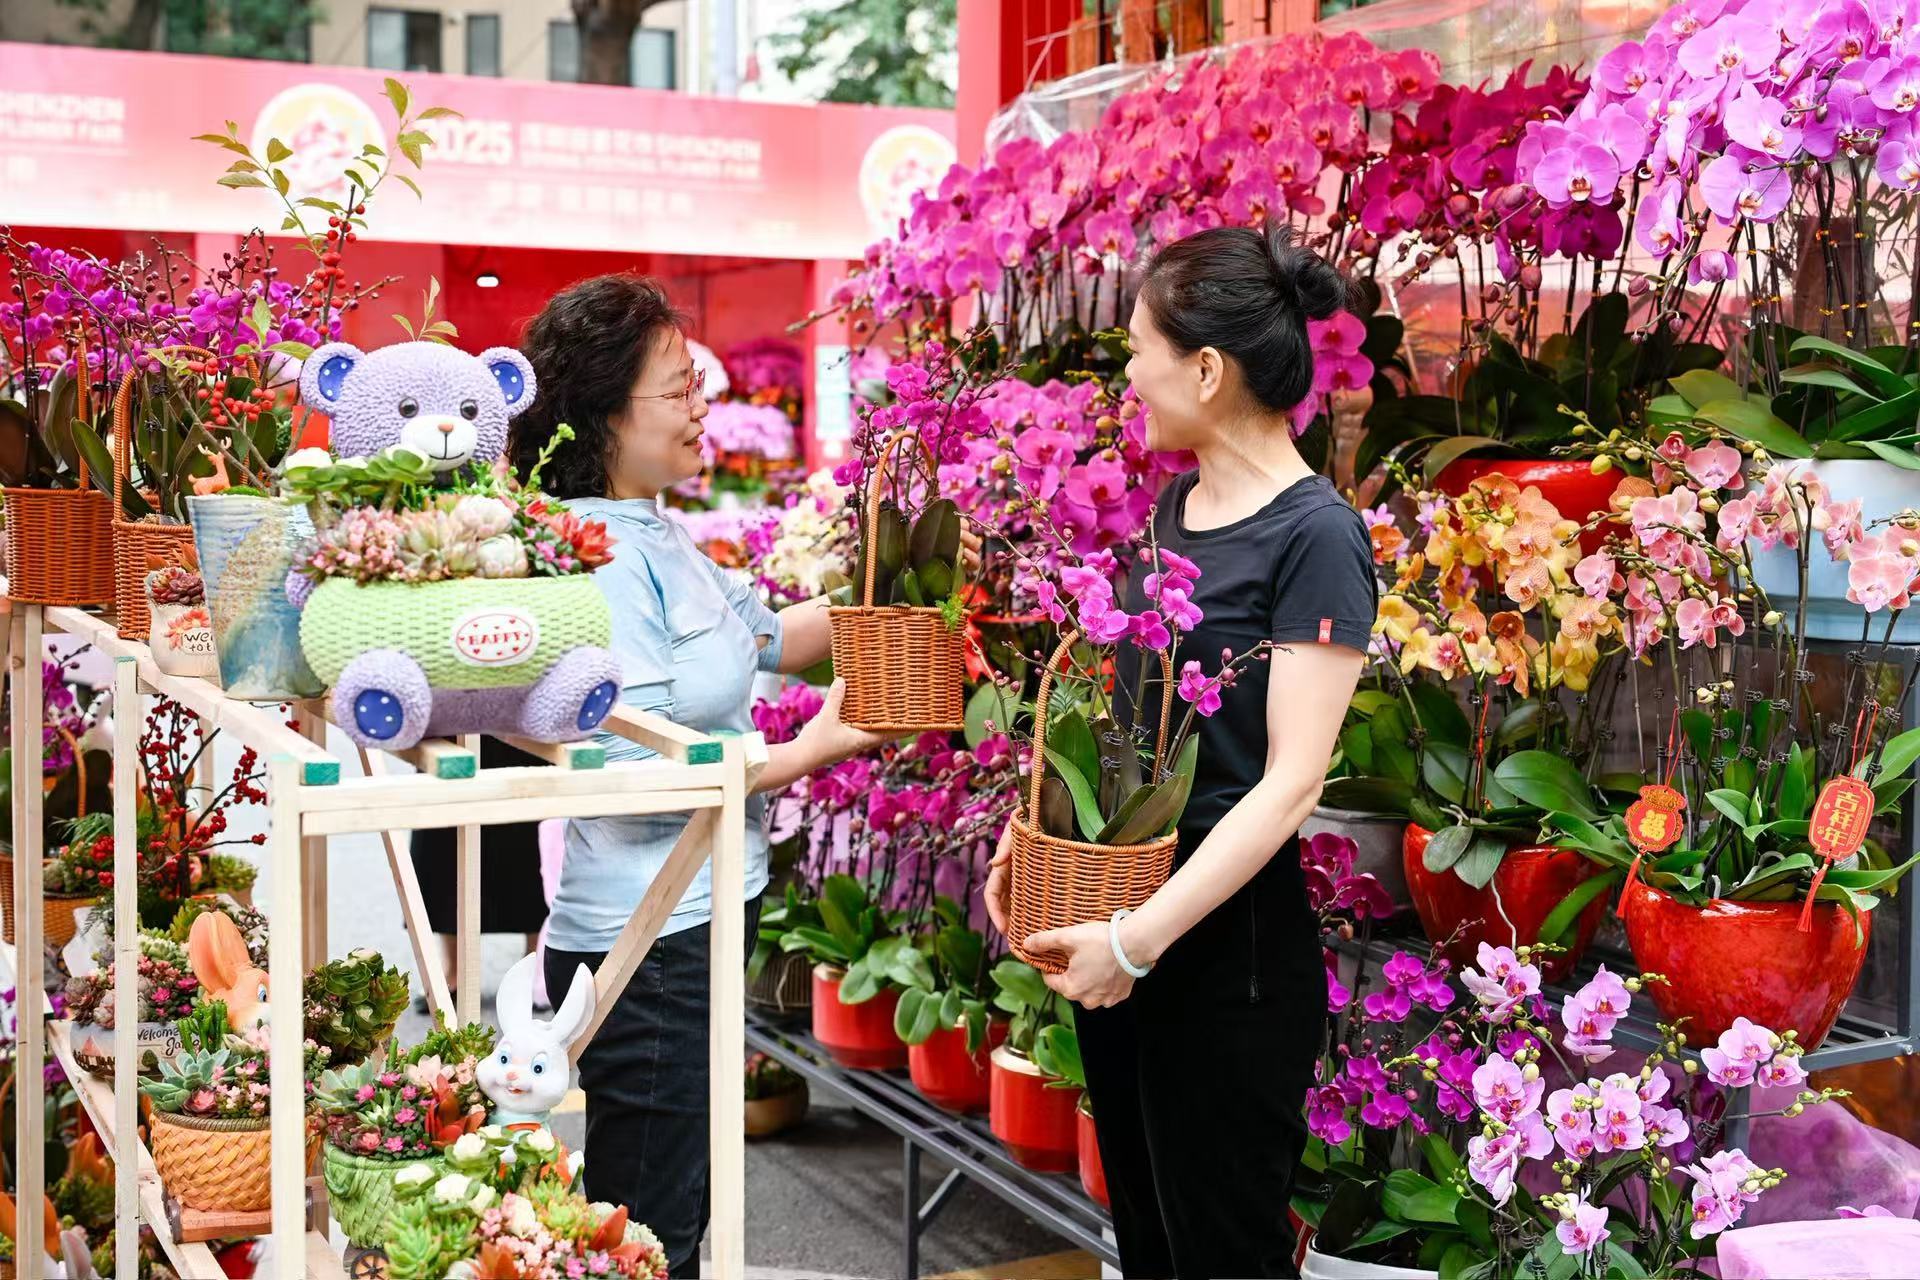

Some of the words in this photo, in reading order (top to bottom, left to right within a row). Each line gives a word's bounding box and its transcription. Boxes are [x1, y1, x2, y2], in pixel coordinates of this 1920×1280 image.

[468, 631, 521, 645] HAPPY
[1639, 809, 1668, 841] 福
[1822, 790, 1861, 848] 吉祥年
